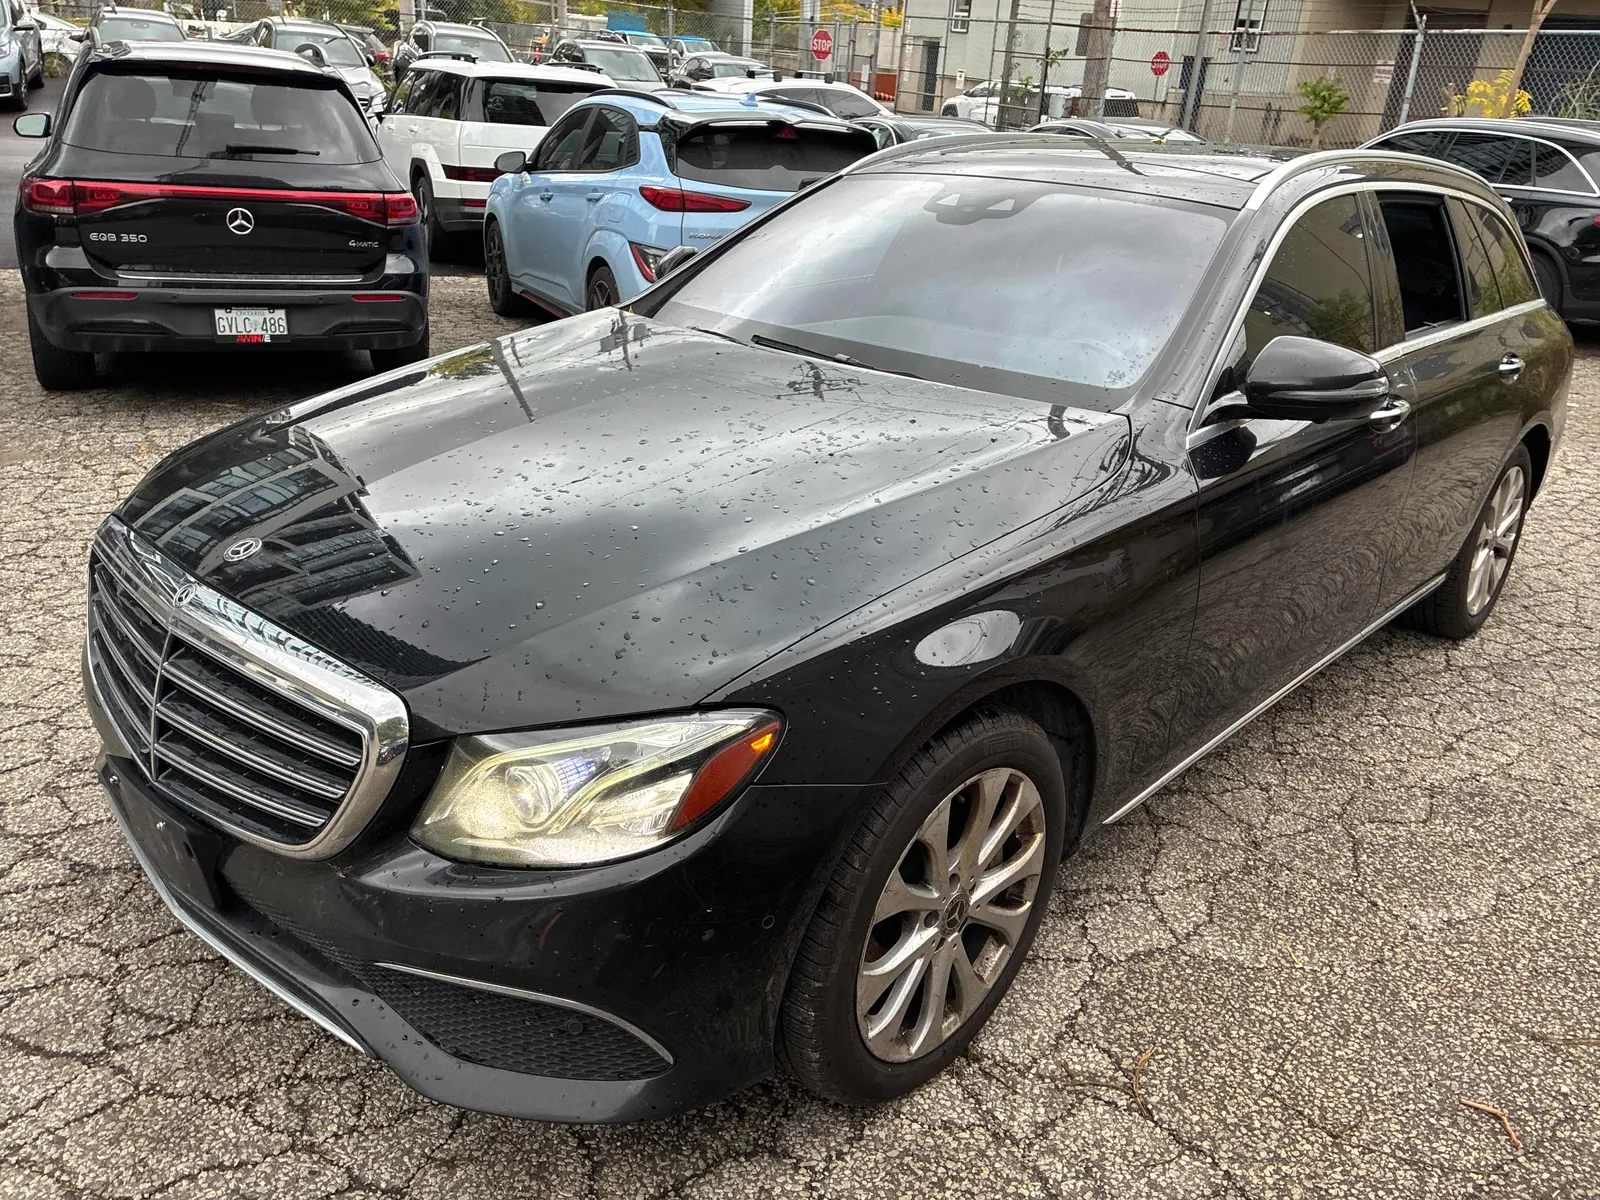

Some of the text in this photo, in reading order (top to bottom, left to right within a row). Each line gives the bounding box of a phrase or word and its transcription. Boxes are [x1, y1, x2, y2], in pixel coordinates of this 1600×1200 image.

[813, 38, 832, 51] STOP
[89, 232, 148, 243] EQB 350
[348, 239, 379, 248] 4MATIC
[217, 316, 286, 334] GVLC 486
